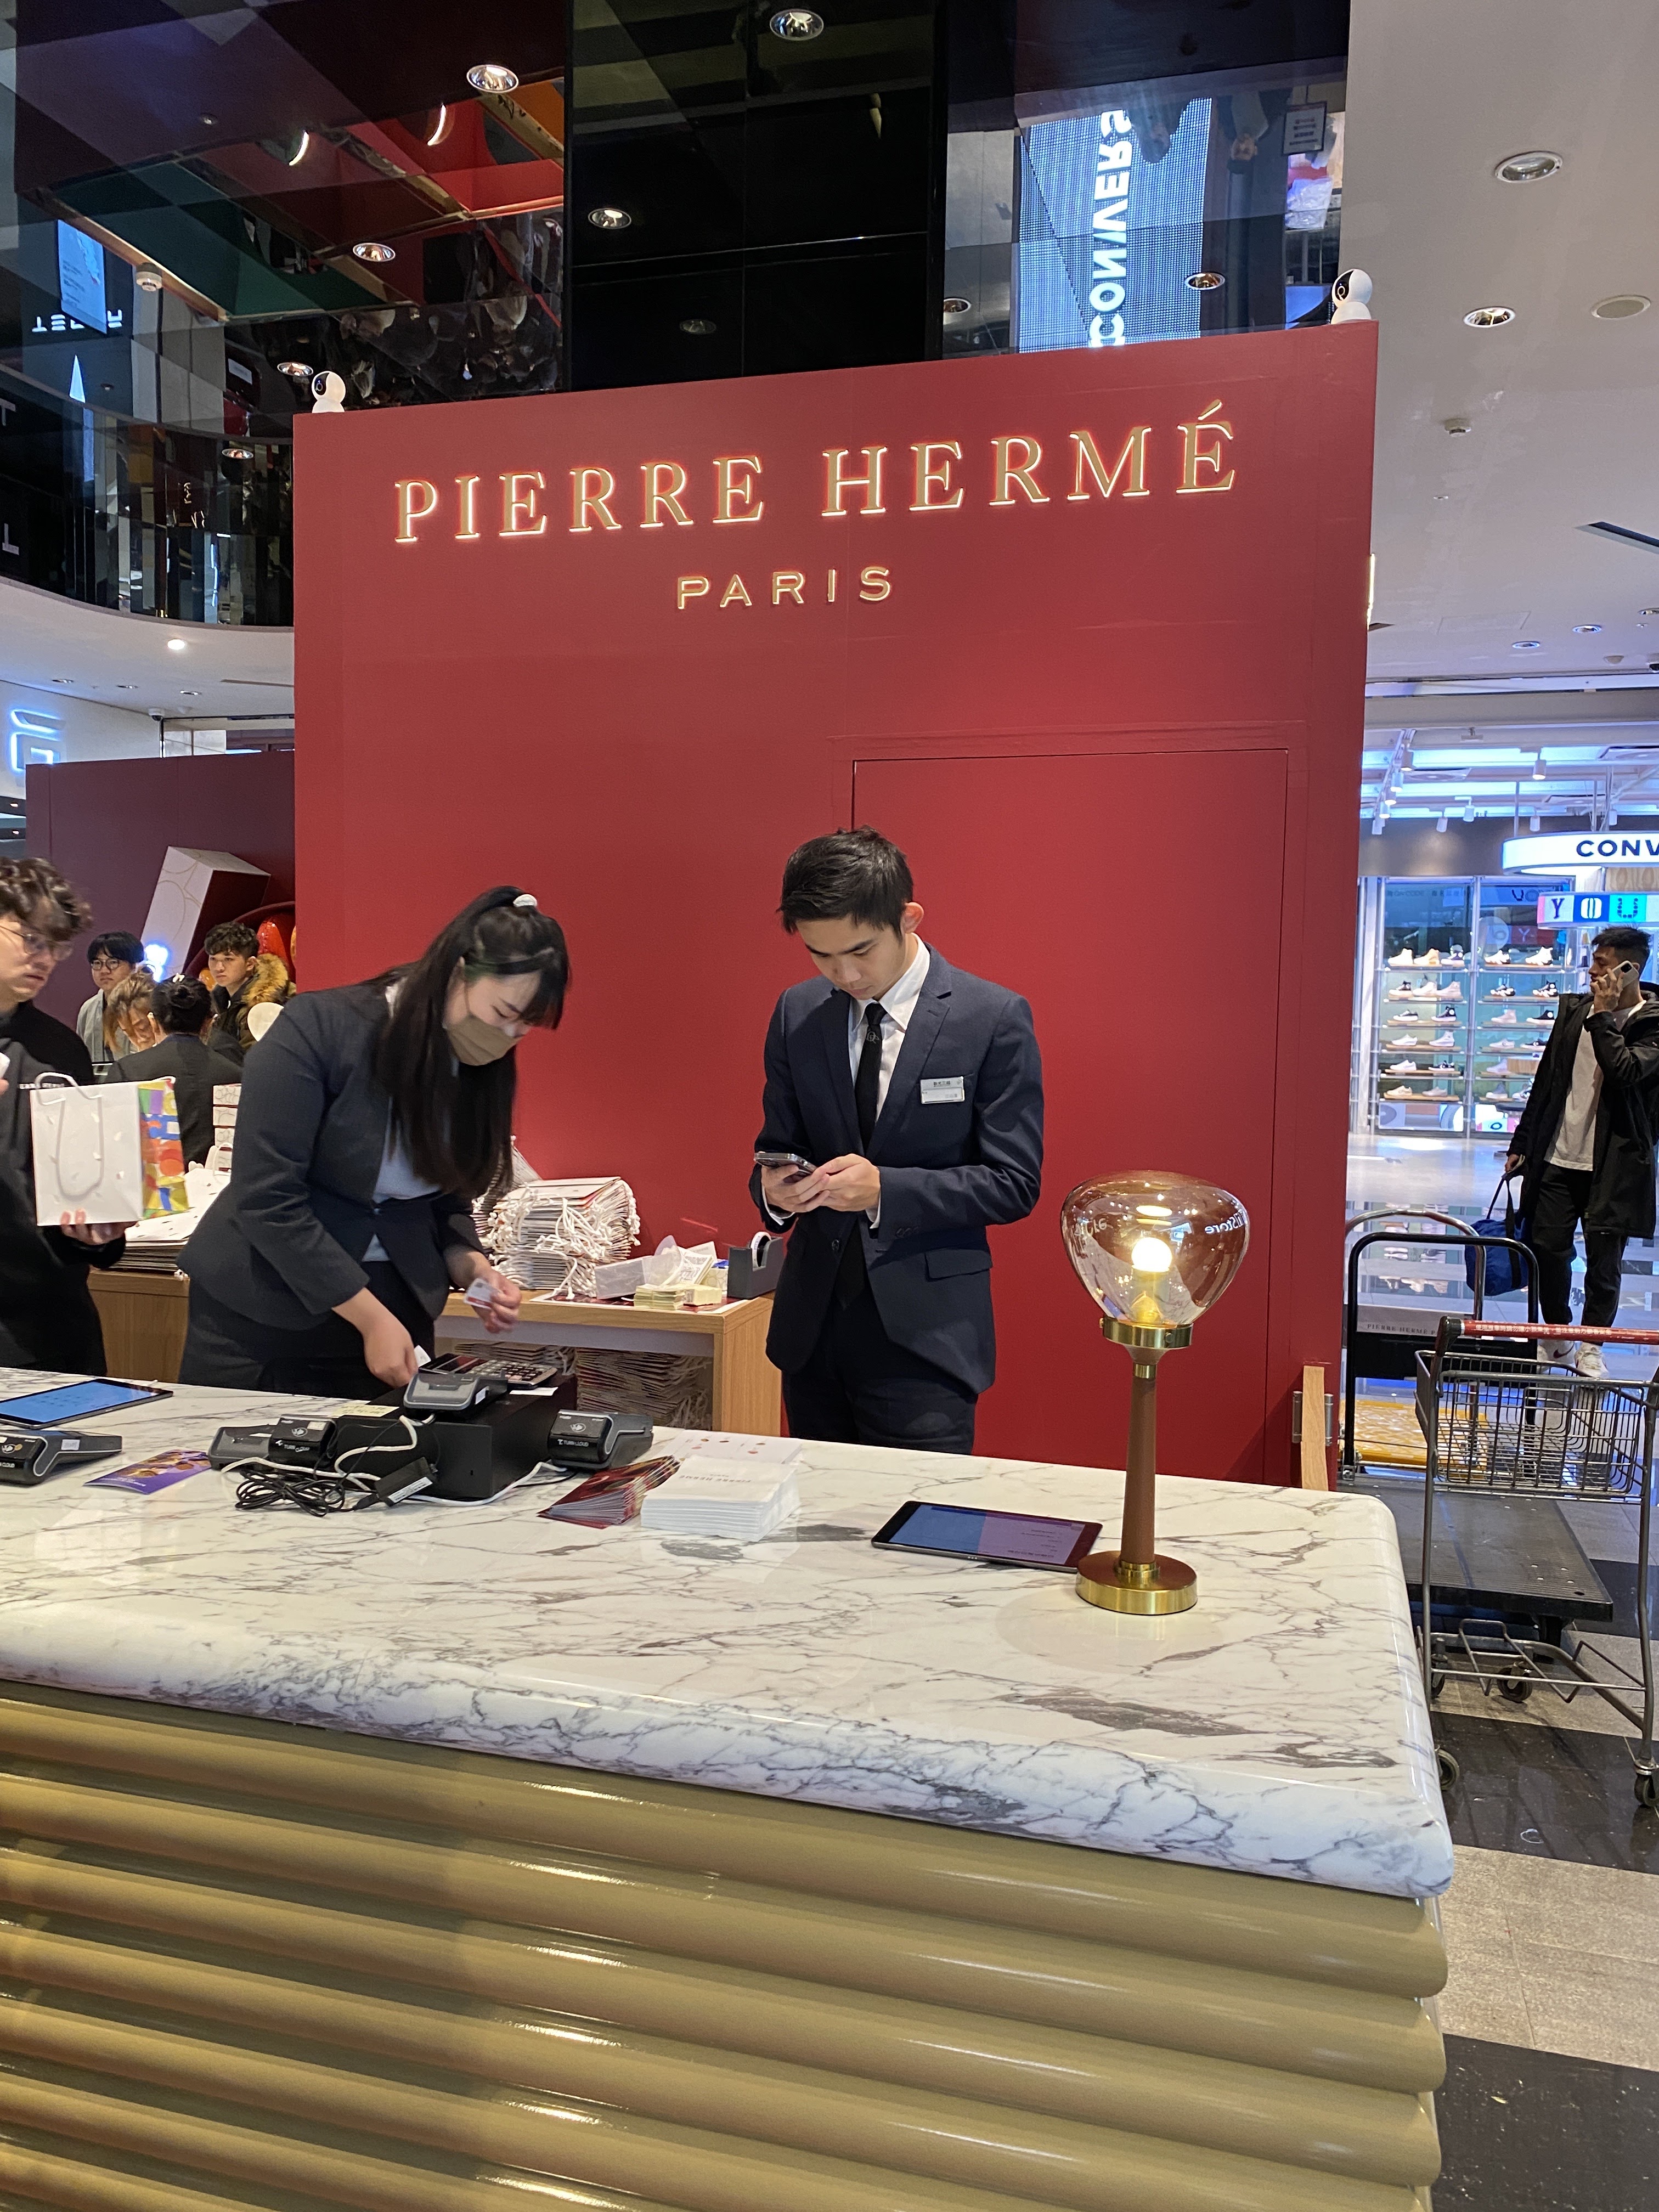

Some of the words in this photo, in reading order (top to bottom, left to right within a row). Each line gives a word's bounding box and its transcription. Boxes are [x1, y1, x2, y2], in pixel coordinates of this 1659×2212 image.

[394, 455, 764, 543] PIERRE
[821, 398, 1235, 517] HERMÉ
[677, 566, 890, 610] PARIS
[1576, 839, 1659, 857] CONV
[1551, 897, 1639, 919] YOU
